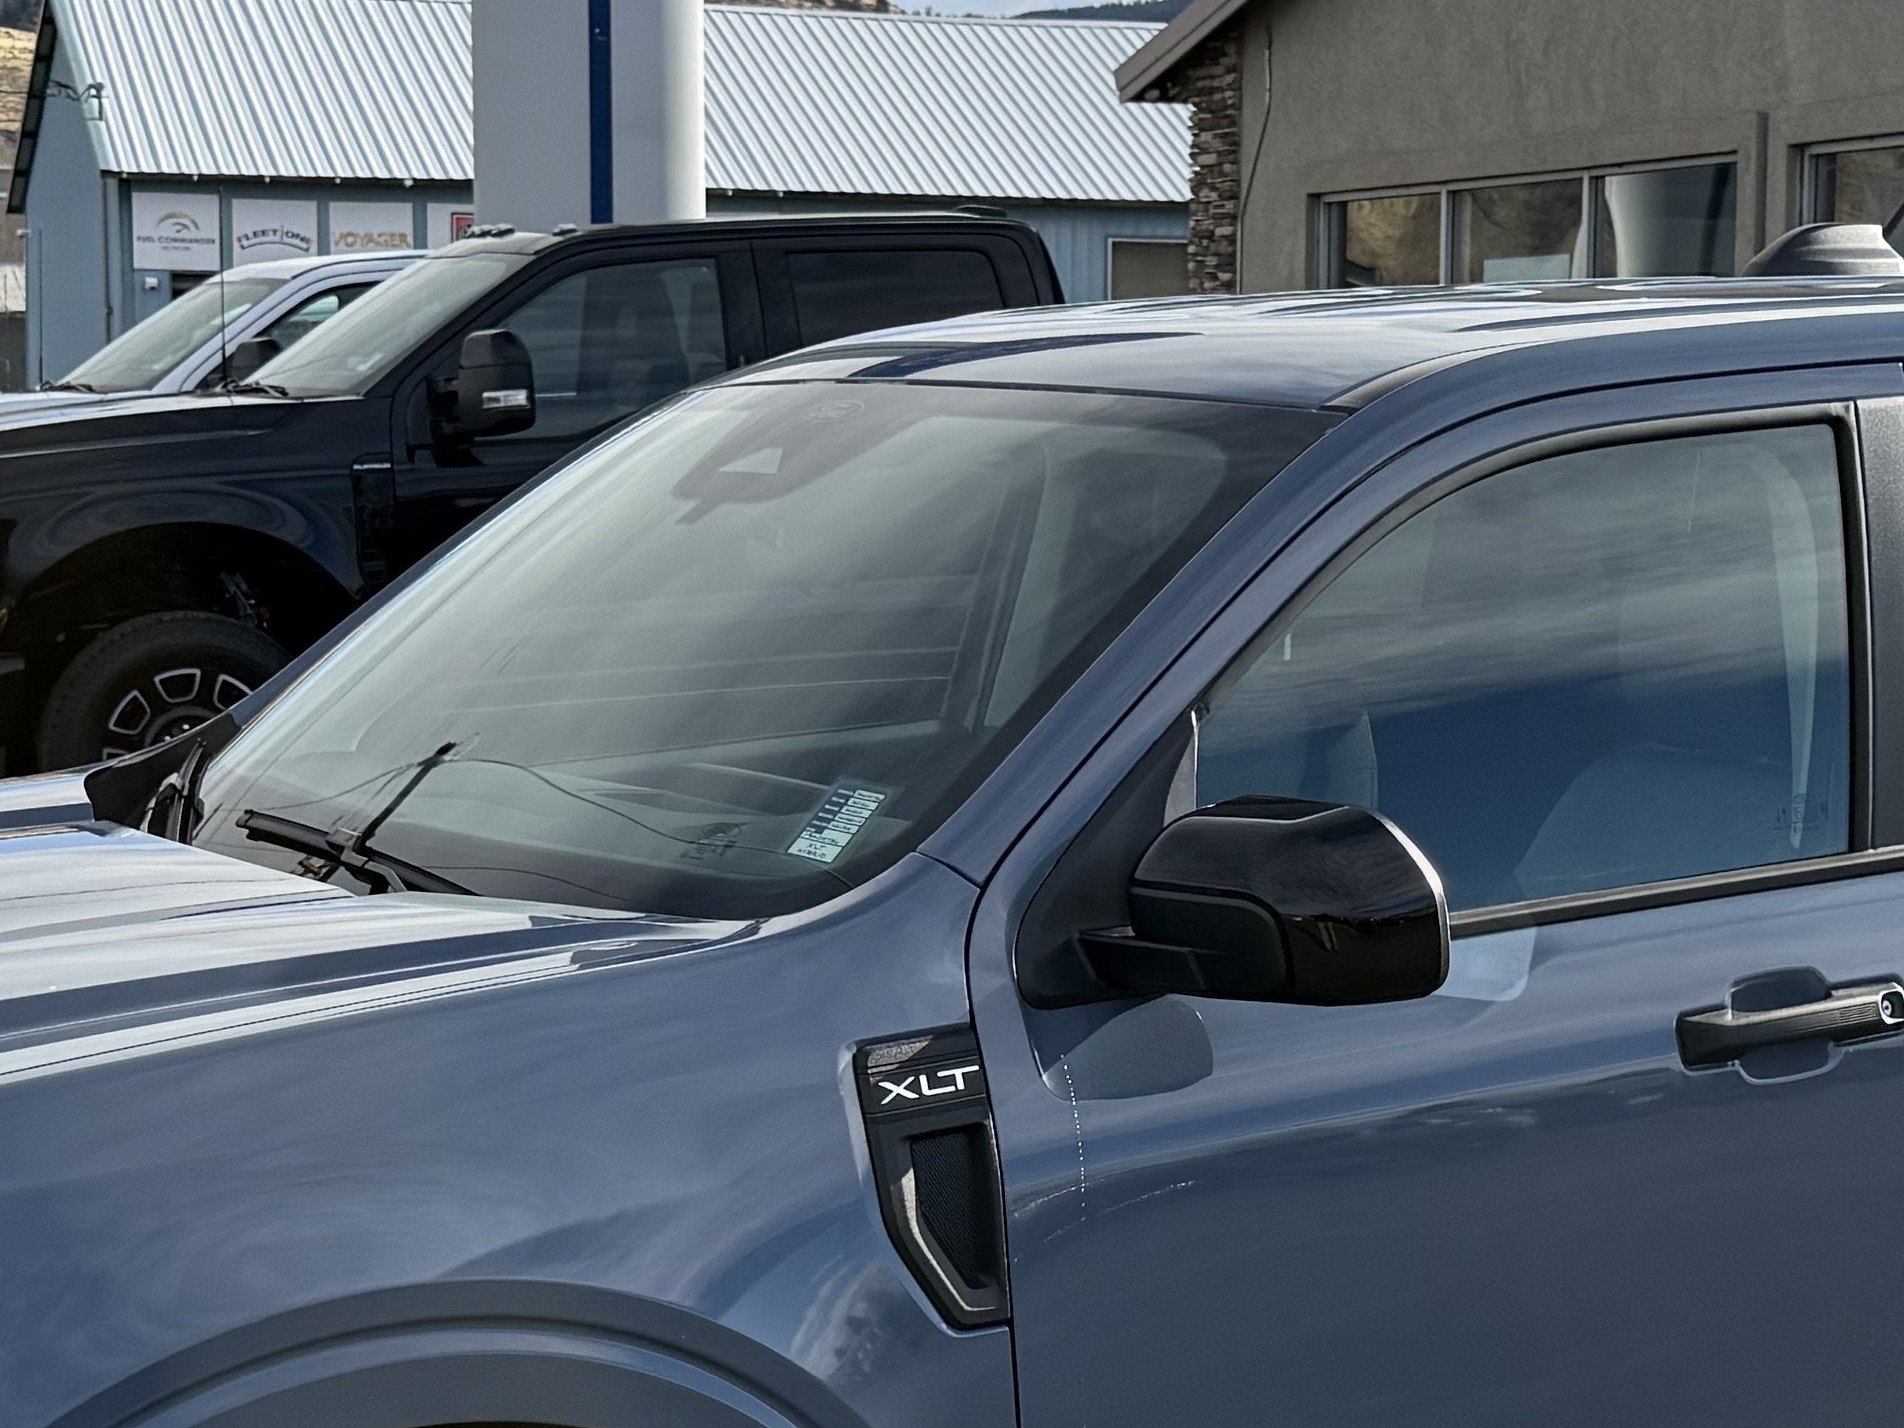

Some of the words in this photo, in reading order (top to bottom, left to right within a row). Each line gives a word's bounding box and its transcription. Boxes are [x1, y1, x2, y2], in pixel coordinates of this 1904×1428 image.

[236, 228, 279, 245] FLEET
[333, 230, 413, 249] VOYAGER
[878, 1064, 980, 1105] XLT
